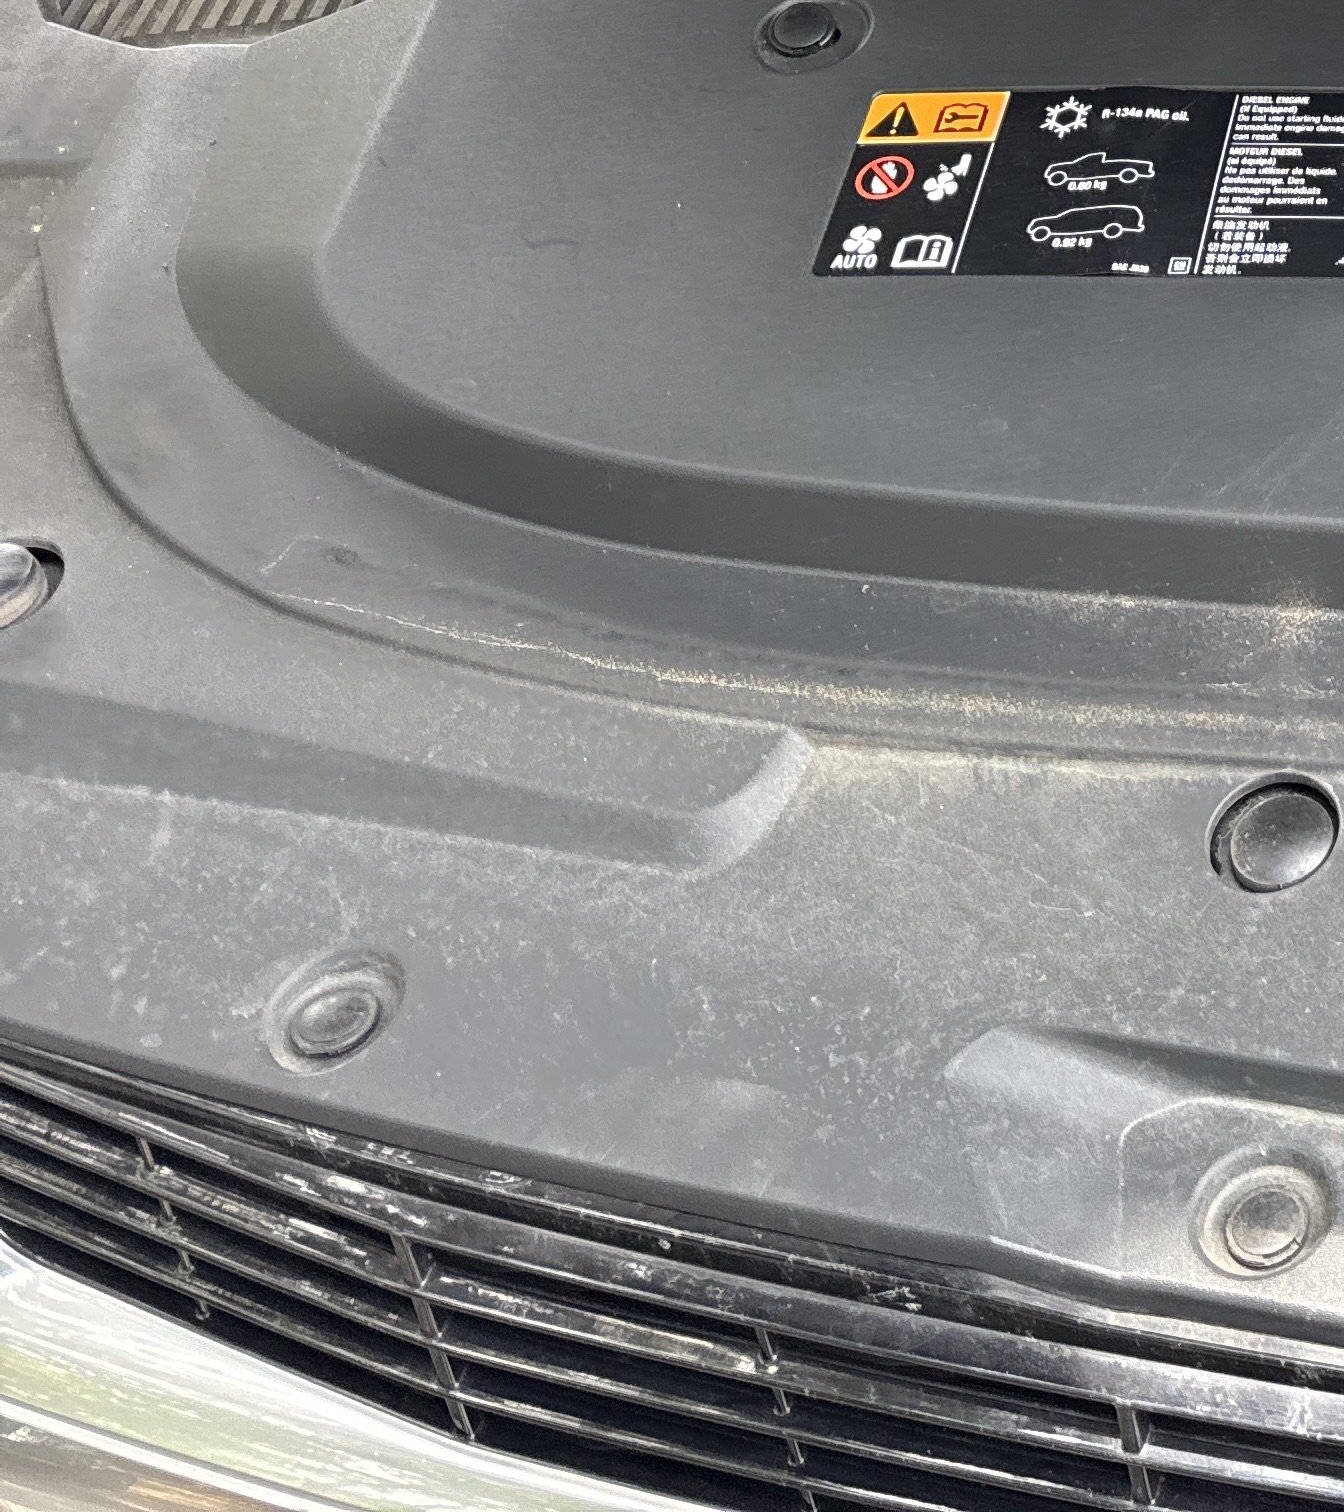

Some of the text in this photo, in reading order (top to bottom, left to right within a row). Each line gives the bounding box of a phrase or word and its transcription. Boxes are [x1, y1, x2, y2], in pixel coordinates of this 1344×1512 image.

[1241, 95, 1311, 105] DIESEL ENGINE
[1101, 107, 1190, 121] R-134a PAG oil.
[1286, 114, 1321, 124] starting
[1283, 124, 1315, 133] engine
[1228, 147, 1269, 156] MOTEUR
[1239, 167, 1257, 175] pas
[1291, 167, 1304, 175] de
[1093, 179, 1108, 191] kg
[1231, 196, 1265, 205] moteur
[1315, 197, 1328, 205] en
[1078, 236, 1093, 248] kg
[829, 253, 878, 269] AUTO
